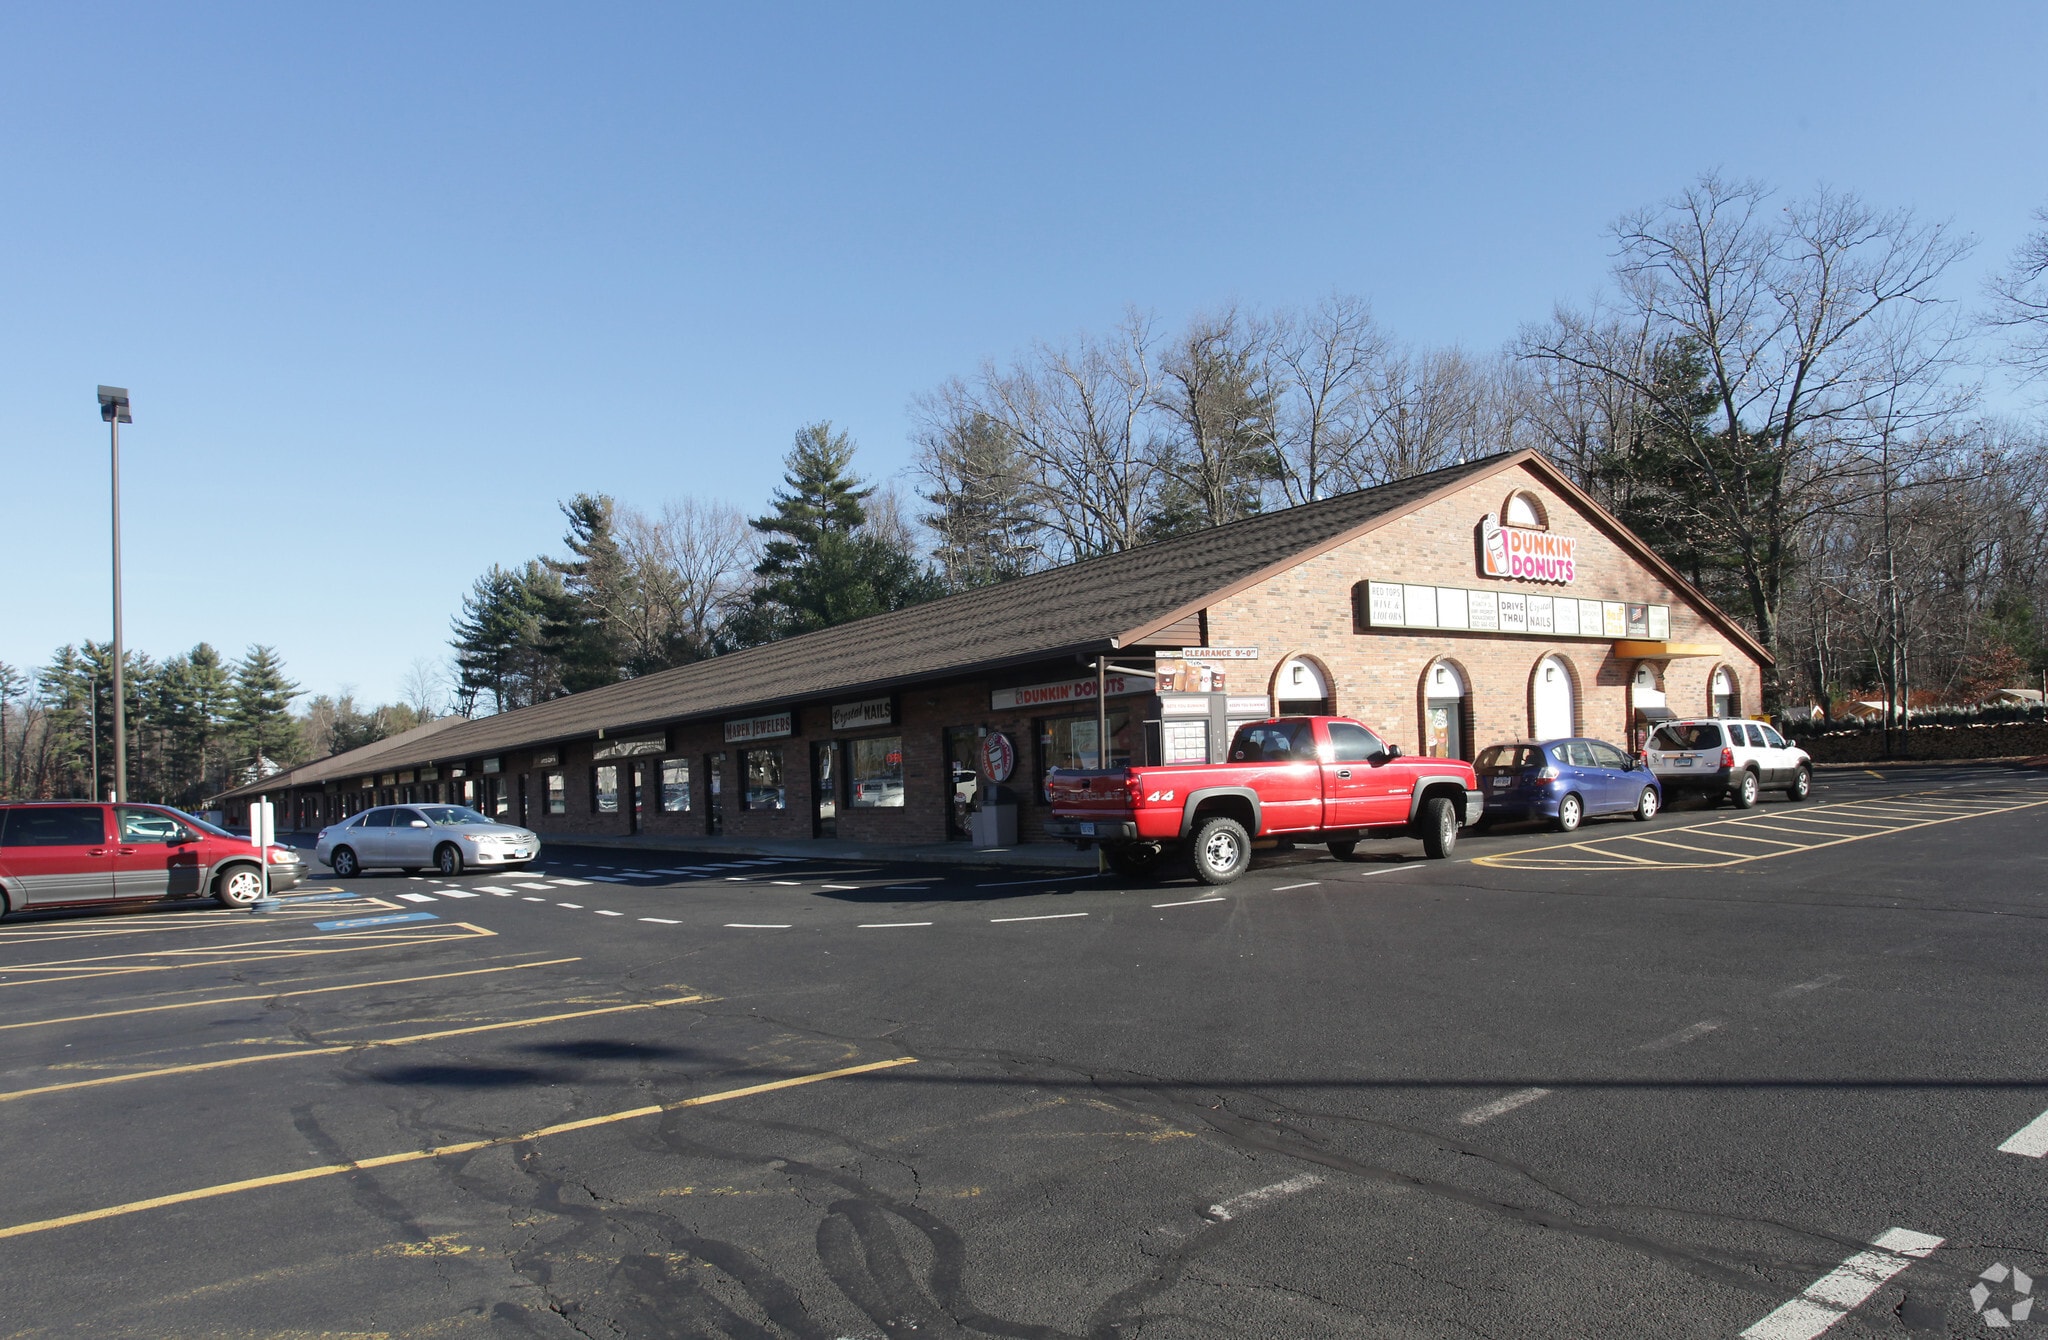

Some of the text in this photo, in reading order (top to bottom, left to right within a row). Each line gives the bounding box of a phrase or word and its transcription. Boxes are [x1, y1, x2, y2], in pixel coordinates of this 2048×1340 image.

[1511, 531, 1575, 558] DUNKIN'
[1512, 555, 1574, 580] DONUTS
[1386, 587, 1400, 597] TOPS
[1501, 601, 1524, 611] DRIVE
[1503, 613, 1524, 623] THRU
[1530, 616, 1551, 627] NAILS
[1185, 649, 1232, 657] CLEARANCE
[1024, 685, 1072, 703] DUNKIN'
[833, 703, 892, 727] Crystal NAILS
[726, 716, 791, 740] MAREK JEWELERS
